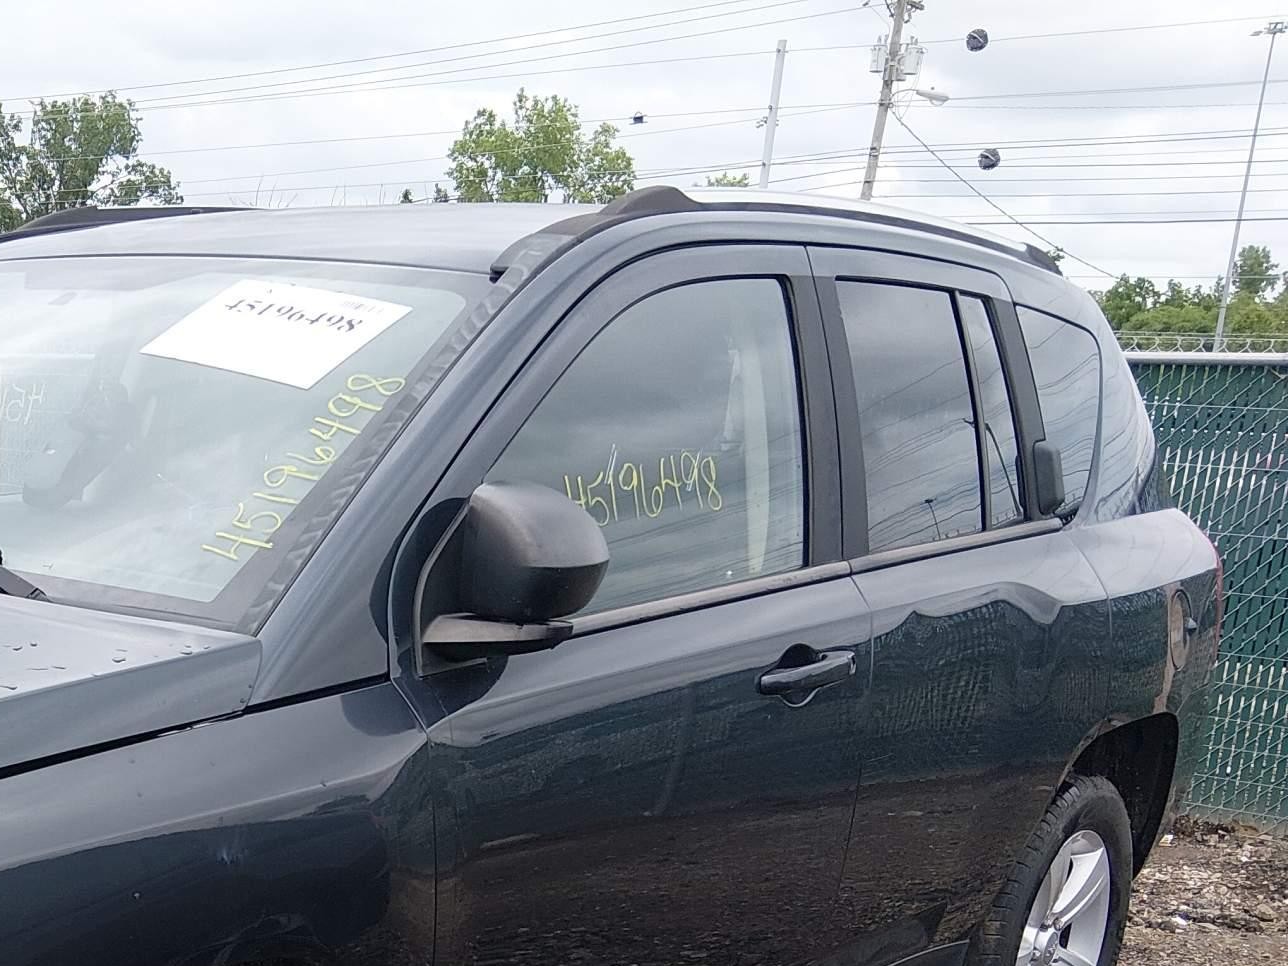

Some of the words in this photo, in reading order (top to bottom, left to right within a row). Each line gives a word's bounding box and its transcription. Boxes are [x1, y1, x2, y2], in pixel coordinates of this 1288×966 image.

[225, 299, 363, 332] 45196498
[200, 373, 406, 561] 45196498
[563, 445, 722, 527] 45196498
